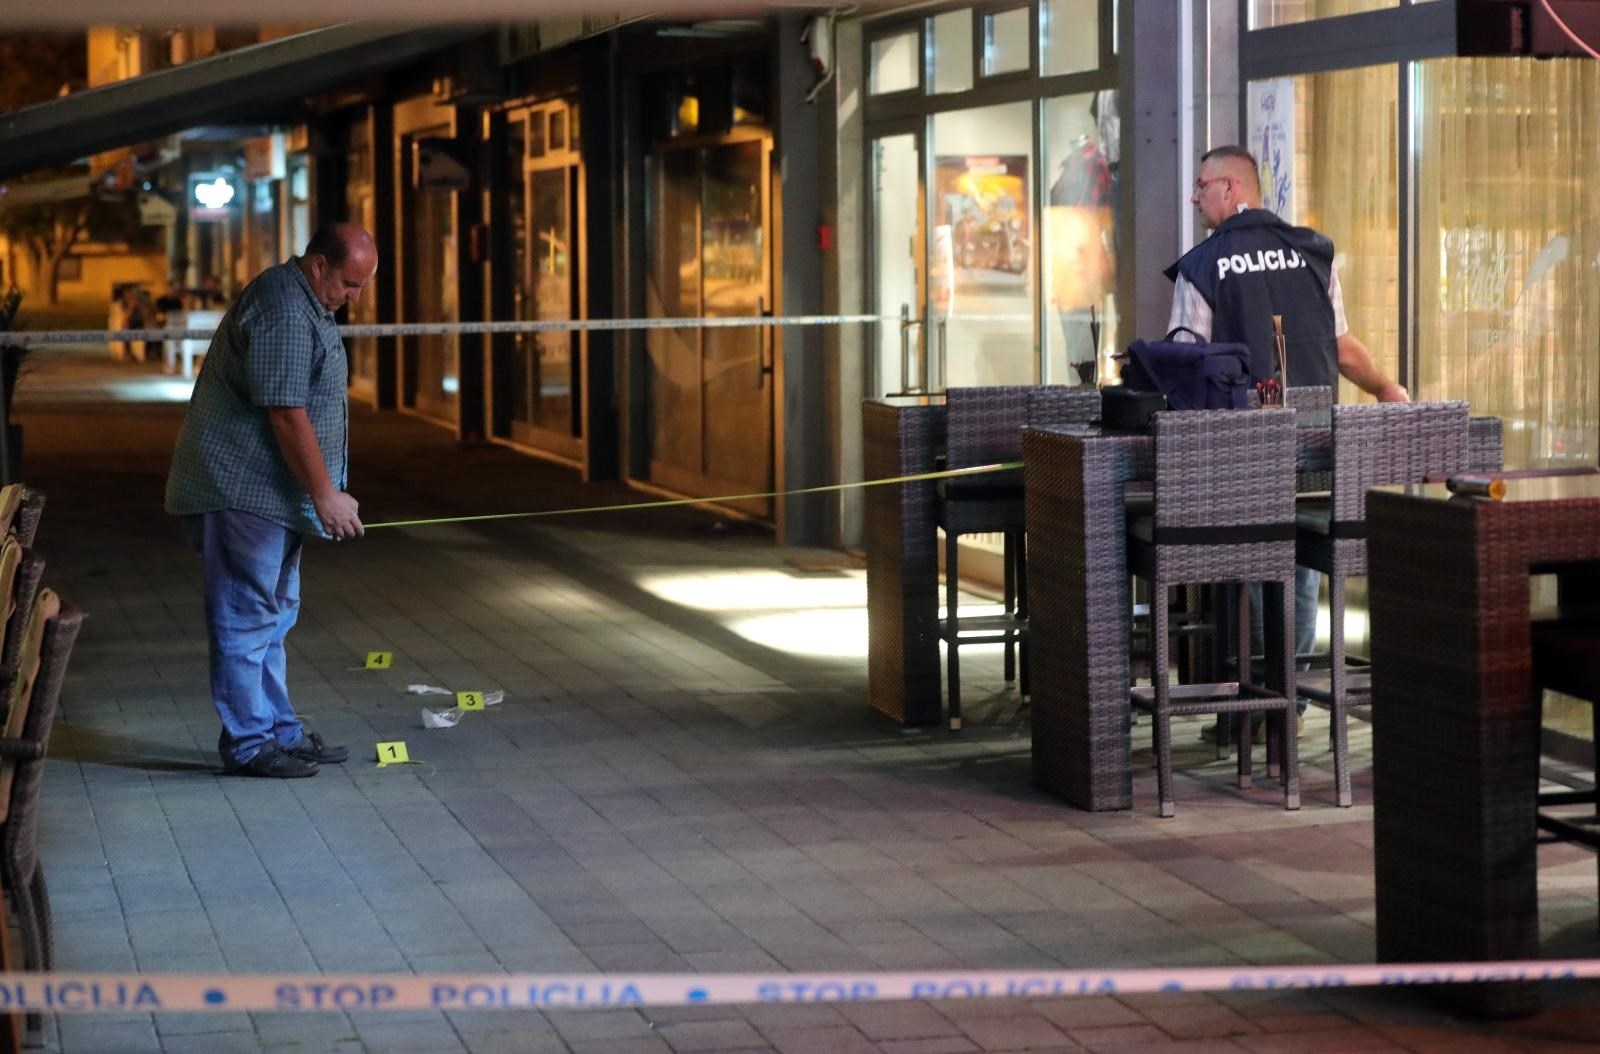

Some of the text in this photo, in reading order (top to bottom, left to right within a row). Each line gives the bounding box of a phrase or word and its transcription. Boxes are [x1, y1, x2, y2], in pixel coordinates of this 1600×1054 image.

[374, 654, 383, 665] 4
[465, 694, 476, 706] 3
[387, 745, 397, 758] 1
[0, 982, 162, 1008] LICIJA
[274, 982, 644, 1009] STOP POLICIJA
